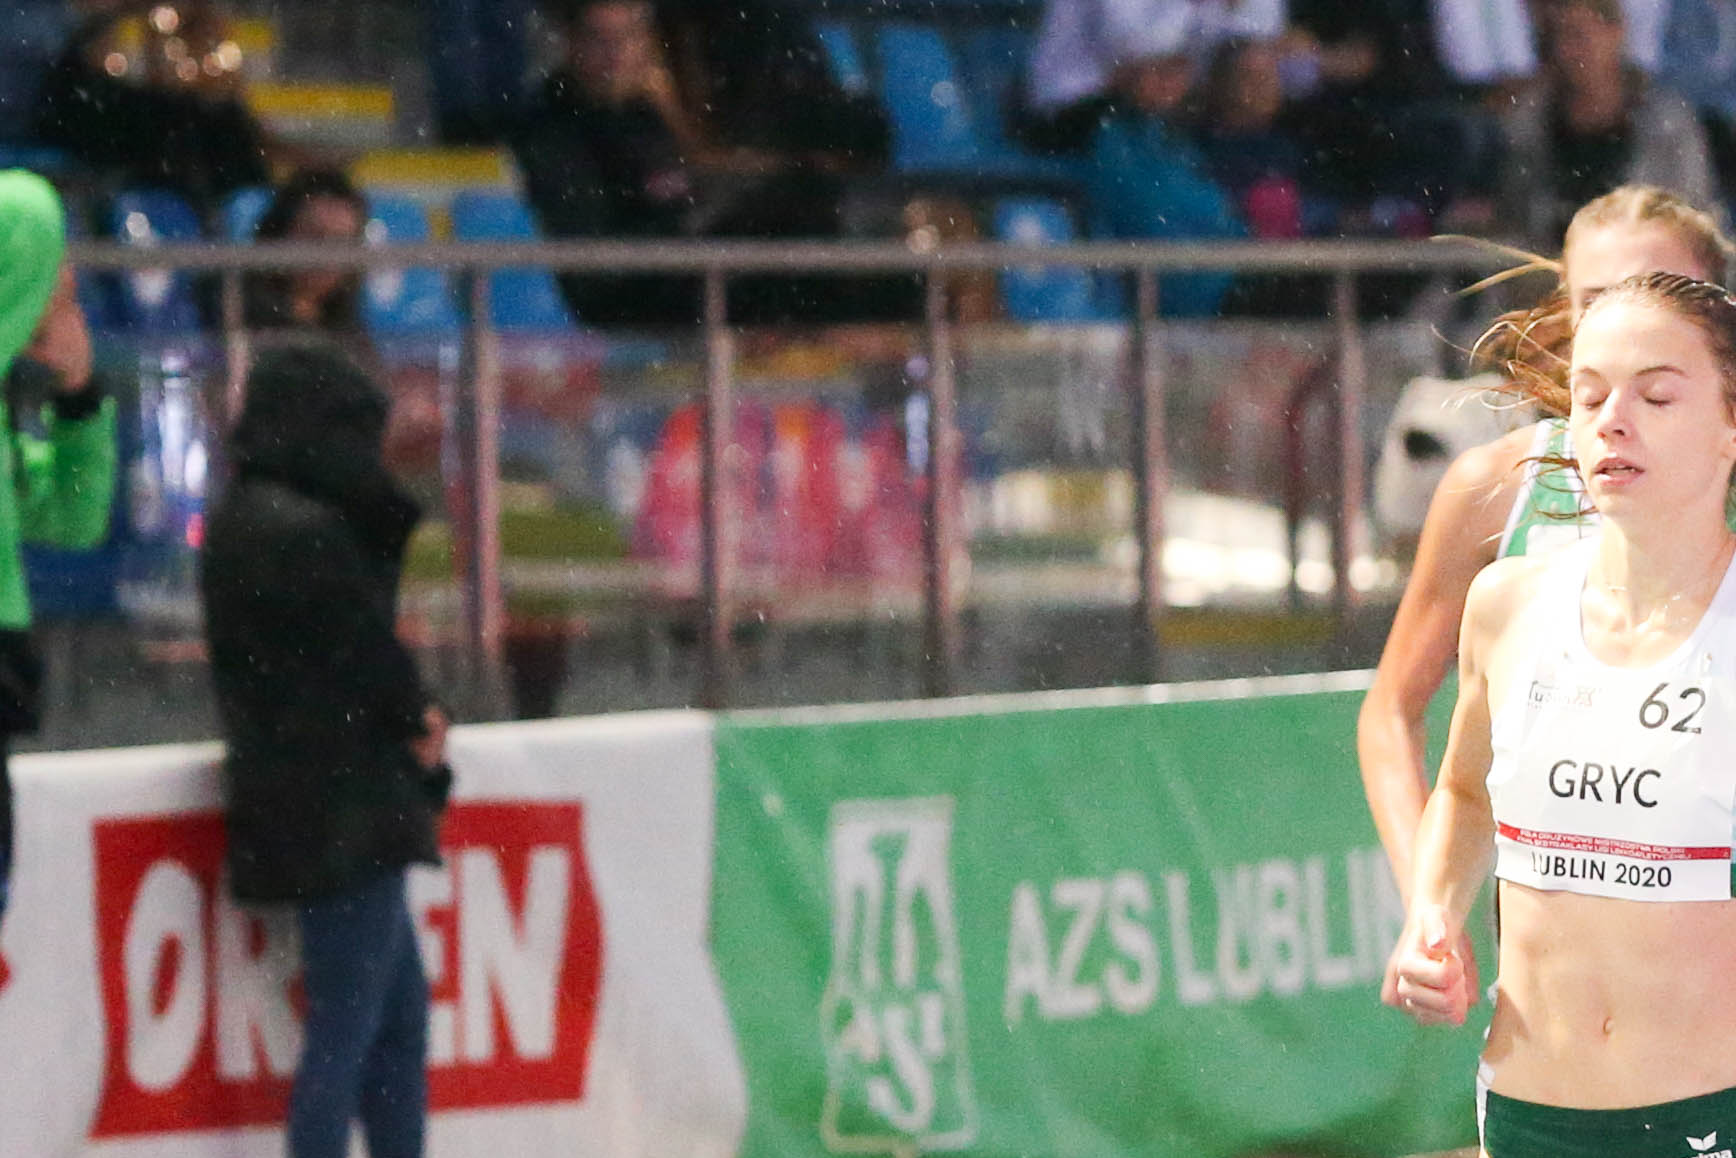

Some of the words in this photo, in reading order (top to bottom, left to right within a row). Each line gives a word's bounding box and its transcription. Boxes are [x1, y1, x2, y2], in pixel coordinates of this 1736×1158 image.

[1639, 682, 1706, 734] 62
[1548, 759, 1662, 808] GRYC
[1614, 862, 1672, 888] 2020
[1003, 870, 1161, 1026] AZS
